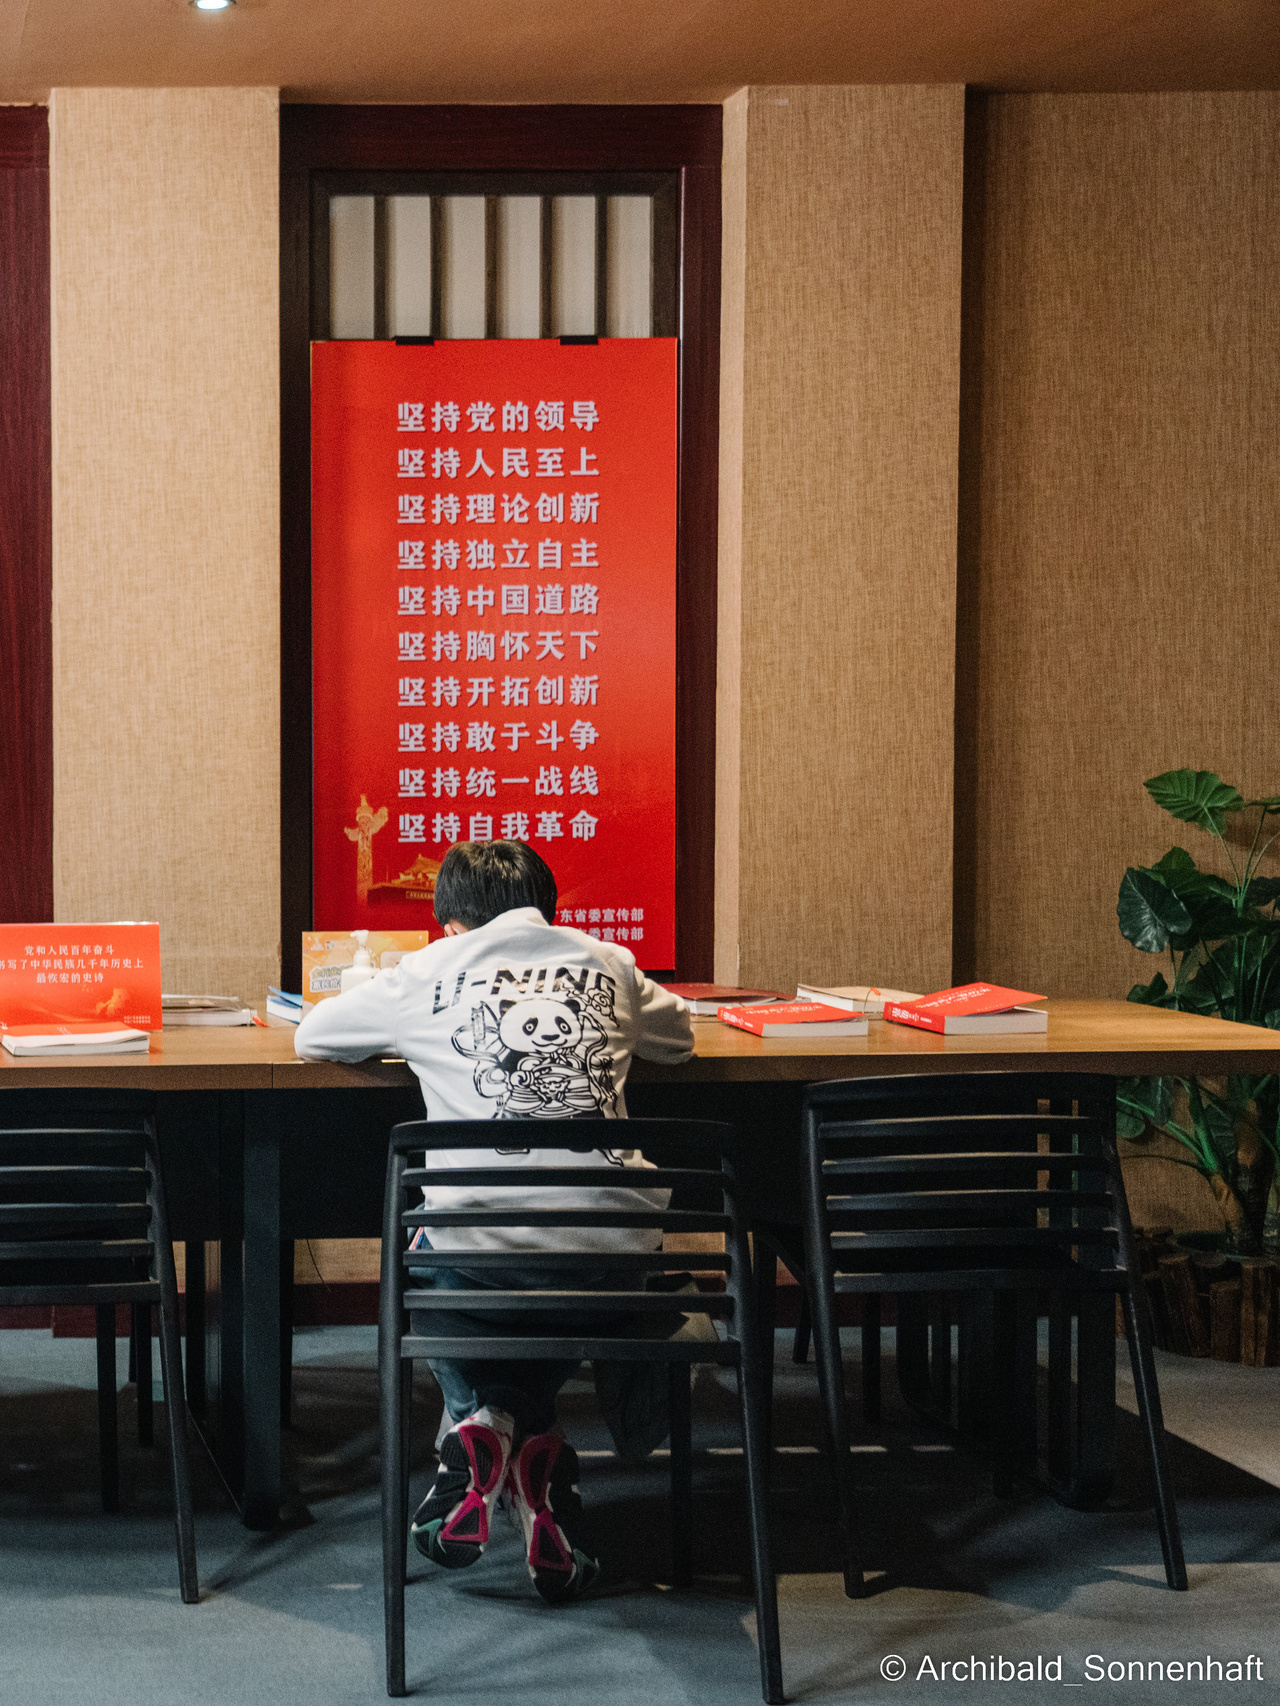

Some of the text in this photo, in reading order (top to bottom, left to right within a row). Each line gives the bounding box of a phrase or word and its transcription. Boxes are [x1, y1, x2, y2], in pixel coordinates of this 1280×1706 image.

[397, 400, 599, 432] 坚持党的领导
[397, 447, 599, 478] 坚持人民至上
[397, 492, 599, 524] 坚持理论创新
[397, 538, 599, 570] 坚持独立自主
[397, 584, 599, 616] 坚持中国道路
[397, 630, 599, 662] 坚持胸怀天下
[397, 675, 599, 707] 坚持开拓创新
[397, 720, 599, 752] 坚持敢于斗争
[397, 766, 599, 798] 坚持统一战线
[398, 810, 599, 843] 坚持自我革命
[556, 908, 644, 923] 东省委宣传部
[24, 944, 115, 956] 党和人民百年奋斗
[36, 972, 104, 984] 最恢宏的史诗
[432, 967, 616, 1014] LI-NING
